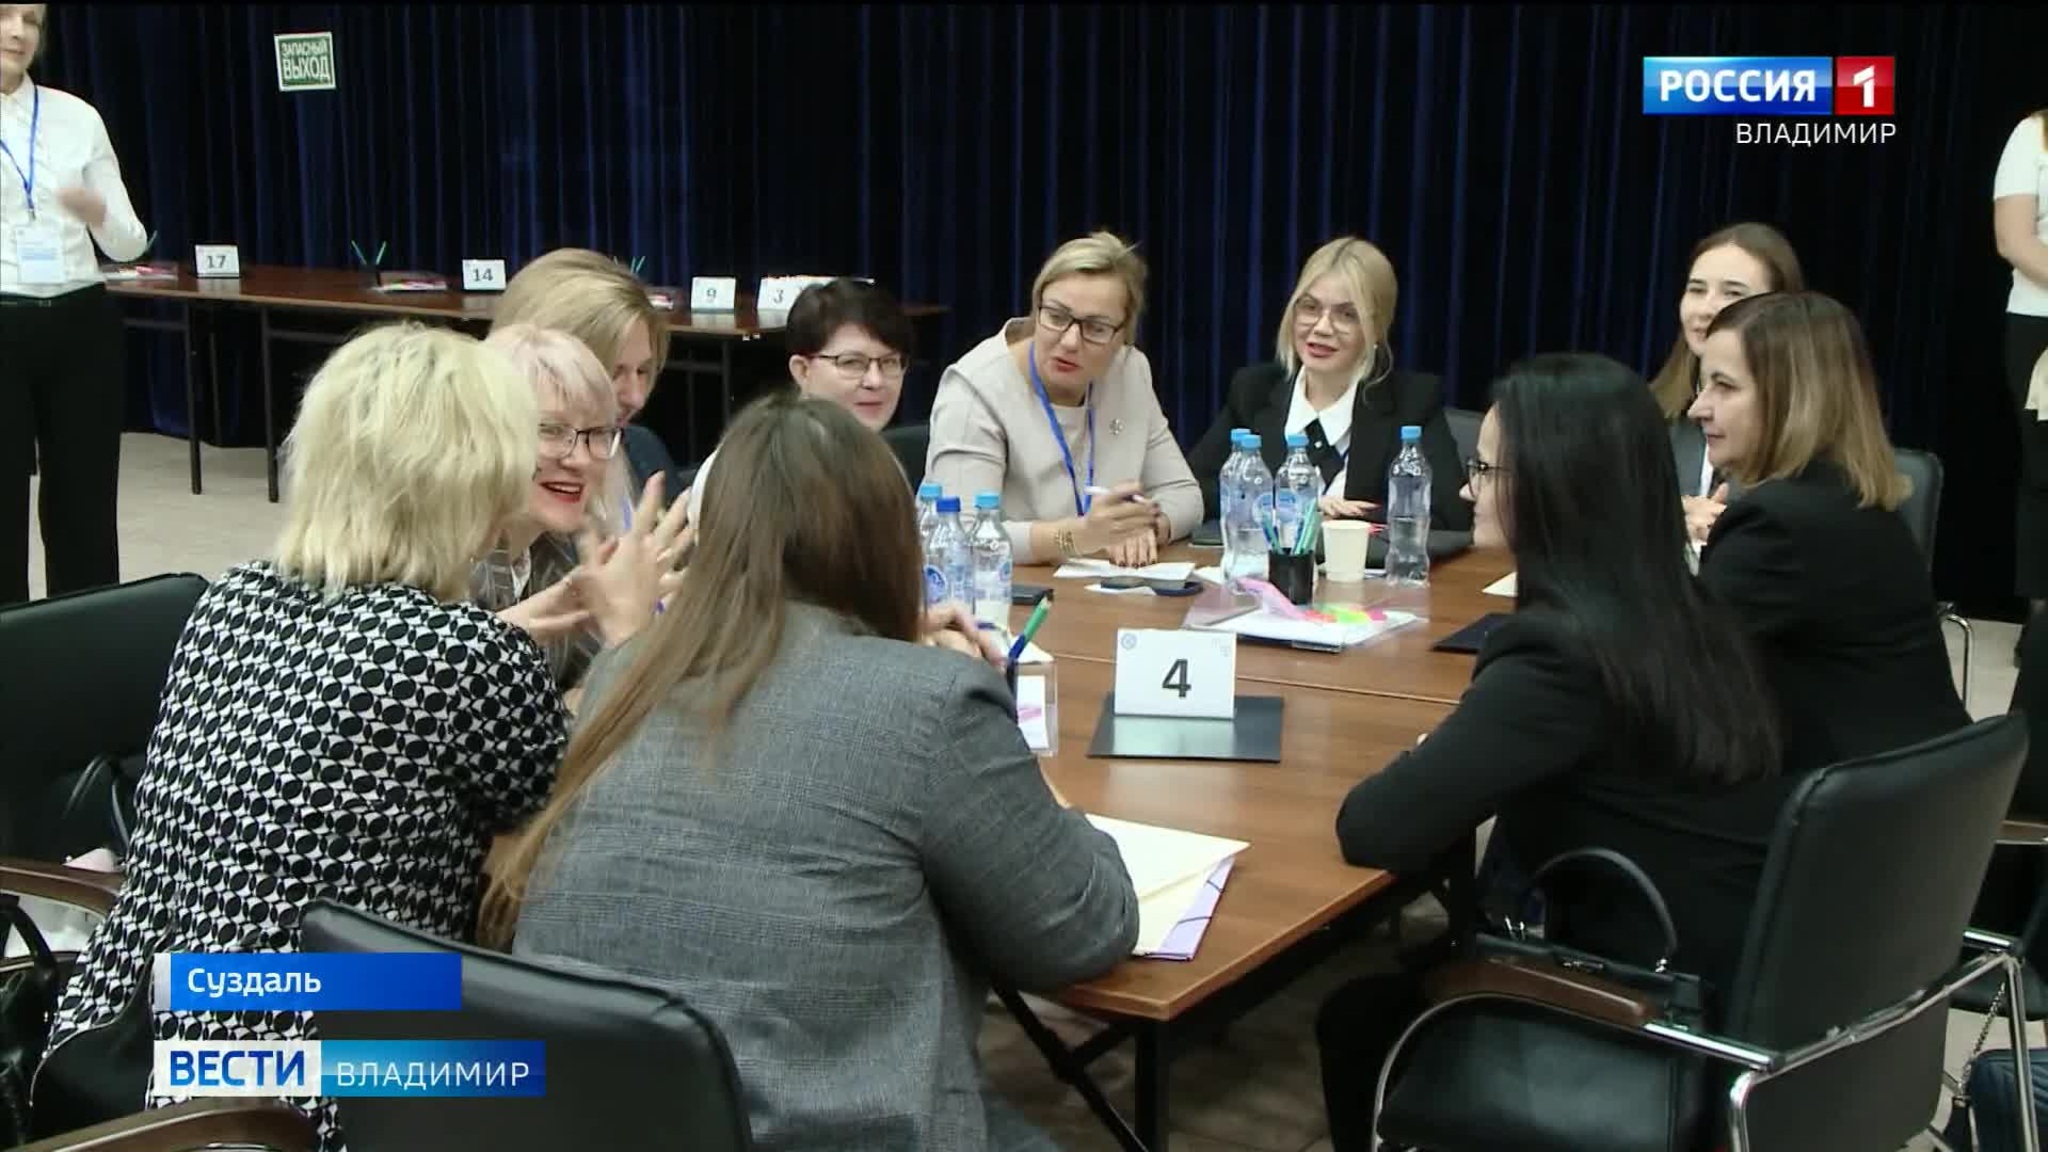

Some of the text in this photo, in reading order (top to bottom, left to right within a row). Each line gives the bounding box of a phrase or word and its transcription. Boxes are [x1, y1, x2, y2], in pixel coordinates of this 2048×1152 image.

[280, 40, 328, 57] ЗАПАСНЫЙ
[282, 56, 331, 80] ВЫХОД
[207, 255, 226, 269] 17
[473, 268, 494, 281] 14
[706, 288, 717, 302] 9
[773, 289, 784, 303] 3
[1162, 659, 1191, 698] 4
